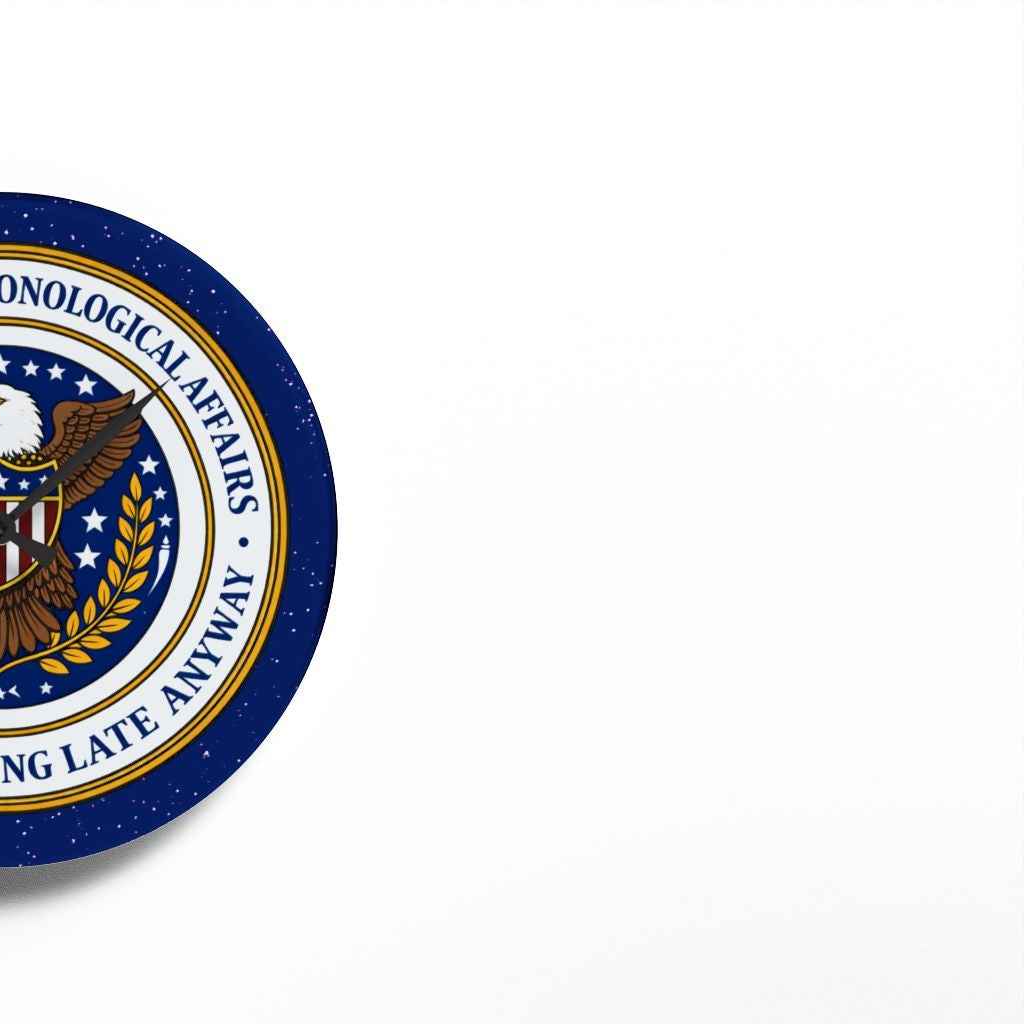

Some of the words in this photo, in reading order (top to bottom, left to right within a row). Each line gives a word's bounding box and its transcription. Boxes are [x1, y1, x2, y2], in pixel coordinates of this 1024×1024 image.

[178, 376, 259, 515] AFFAIRS
[59, 705, 160, 774] LATE
[160, 565, 255, 716] ANYWAY
